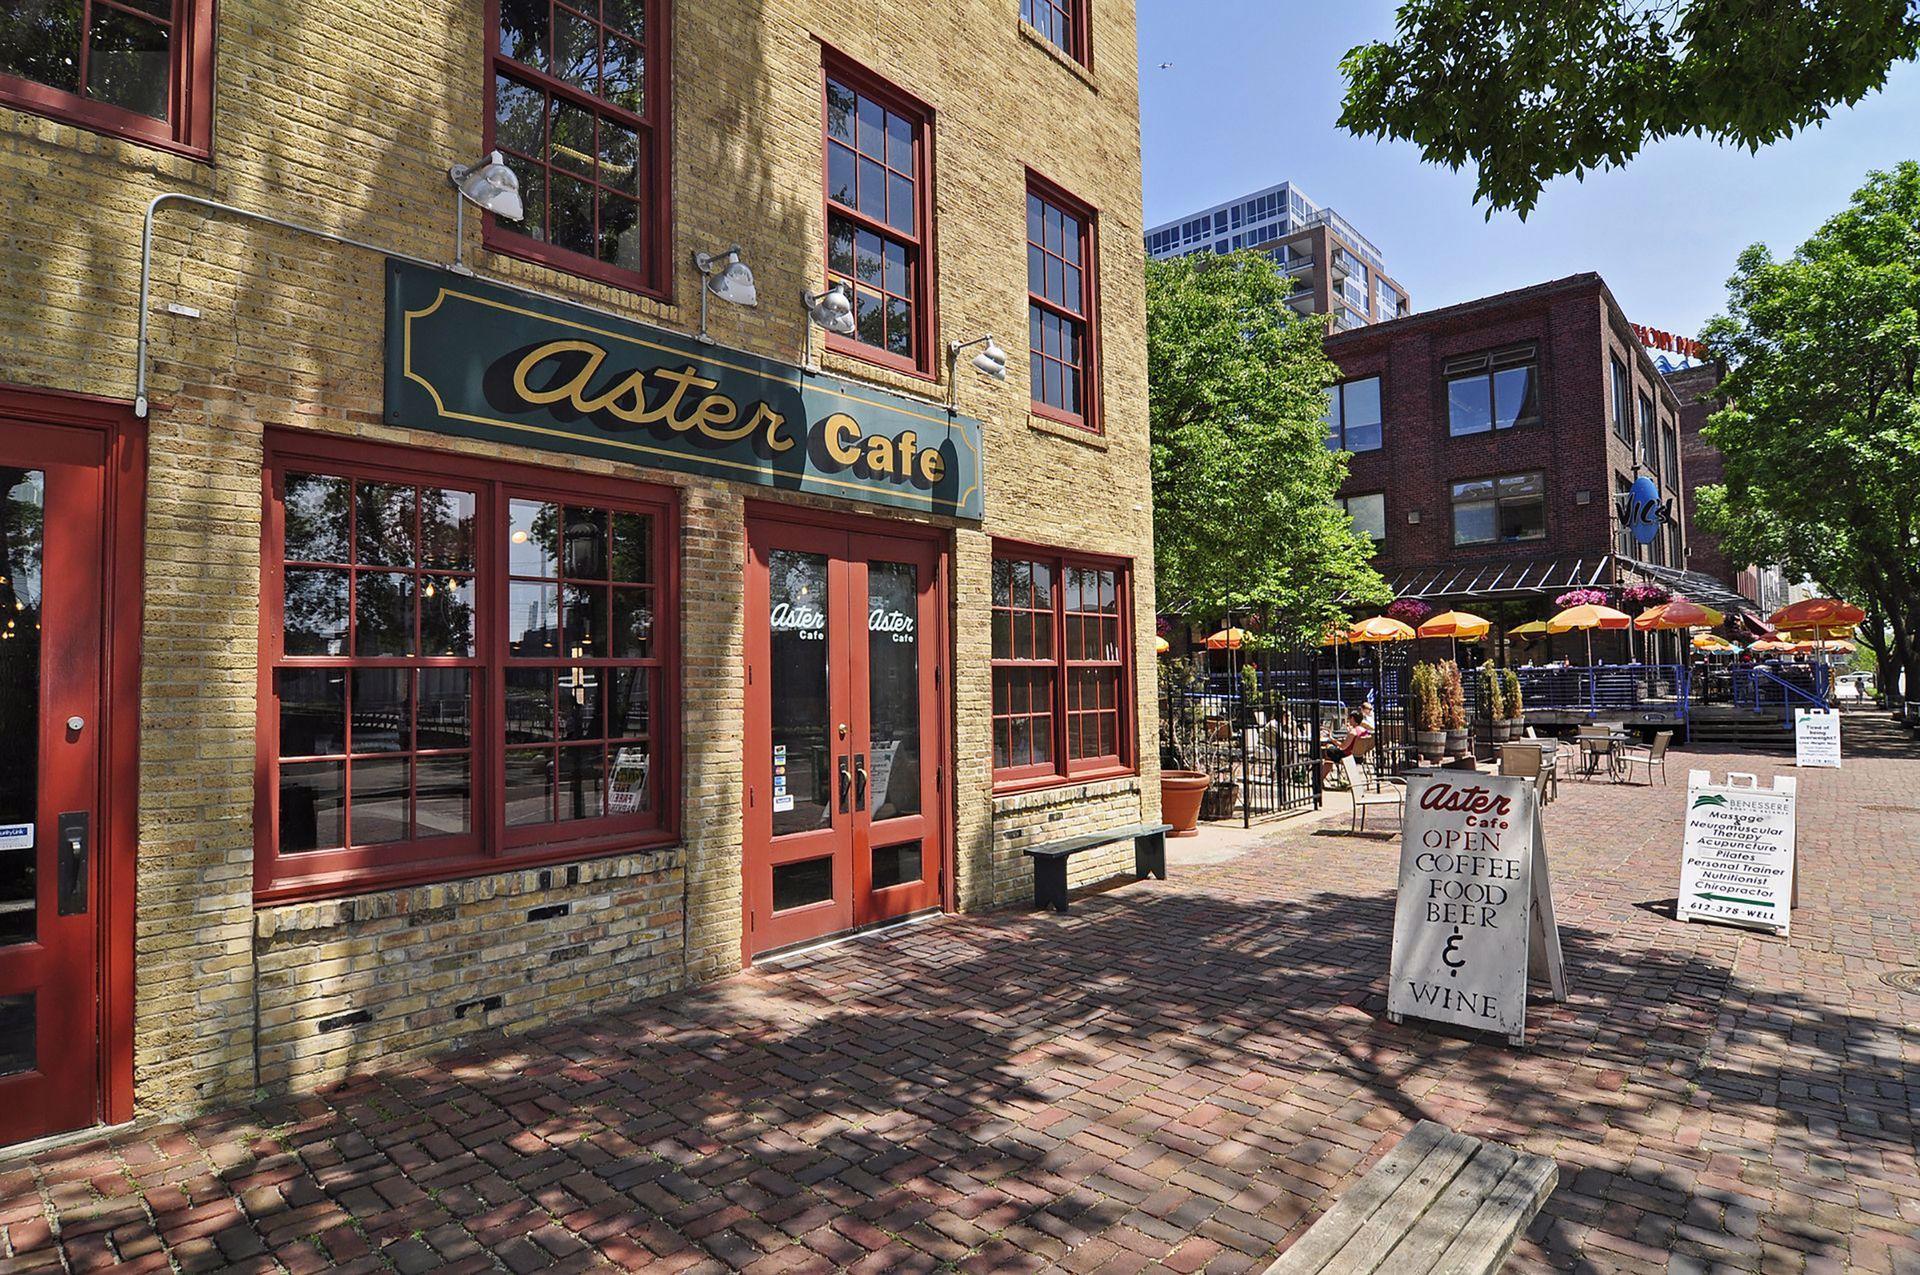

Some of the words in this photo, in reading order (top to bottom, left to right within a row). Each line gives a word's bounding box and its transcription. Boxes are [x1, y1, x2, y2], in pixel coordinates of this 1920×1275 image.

[512, 339, 795, 453] Aster
[824, 412, 946, 483] Cafe
[770, 602, 826, 629] Aster
[868, 609, 914, 633] Aster
[799, 630, 825, 641] Cafe
[892, 633, 914, 643] Cafe
[1420, 783, 1512, 816] Aster
[1730, 799, 1790, 811] BENESSERE
[1466, 815, 1509, 830] Cafe
[1709, 811, 1764, 823] Massage
[1690, 820, 1784, 836] Neuromuscular
[1713, 829, 1762, 842] Therapy
[1423, 829, 1502, 852] OPEN
[1697, 837, 1777, 852] Acupuncture
[1716, 850, 1756, 861] Pilates
[1415, 853, 1521, 881] COFFEE
[1687, 858, 1740, 871] Personal
[1743, 864, 1786, 876] Trainer
[1702, 871, 1768, 885] Nutritionist
[1429, 879, 1508, 906] FOOD
[1695, 881, 1775, 898] Chiropractor
[1426, 902, 1499, 929] BEER
[1690, 902, 1775, 920] 612-378-WELL
[1442, 925, 1466, 978] &
[1409, 981, 1499, 1019] WINE
